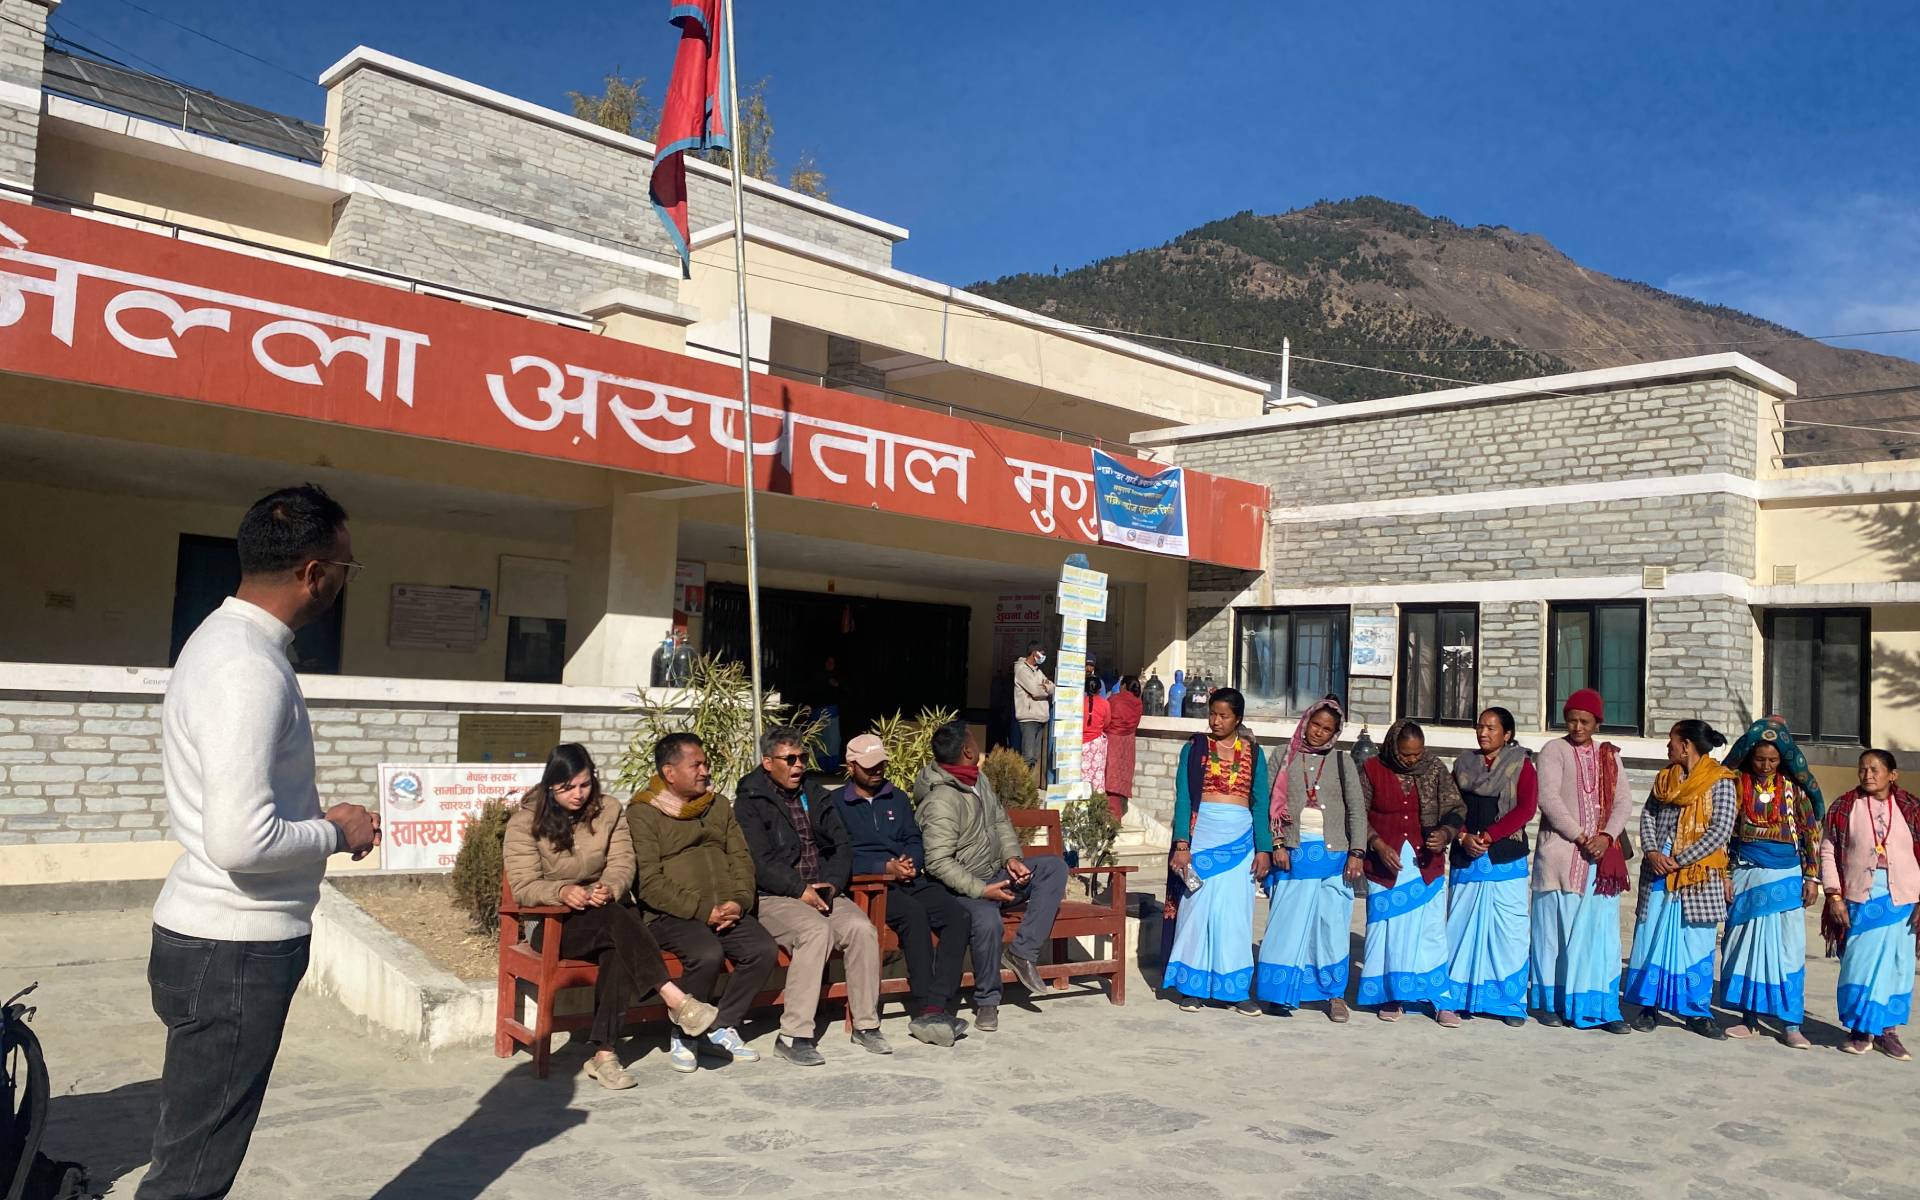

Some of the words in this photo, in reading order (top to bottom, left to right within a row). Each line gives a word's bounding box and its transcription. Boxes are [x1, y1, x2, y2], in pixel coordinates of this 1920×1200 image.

[485, 355, 976, 504] अस्पताल
[466, 771, 488, 782] नेपाल
[490, 773, 518, 783] सरकार
[433, 784, 474, 796] सामाजिक
[478, 784, 505, 796] विकास
[439, 800, 472, 811] स्वास्थ्य
[390, 820, 452, 848] स्वास्थ्य
